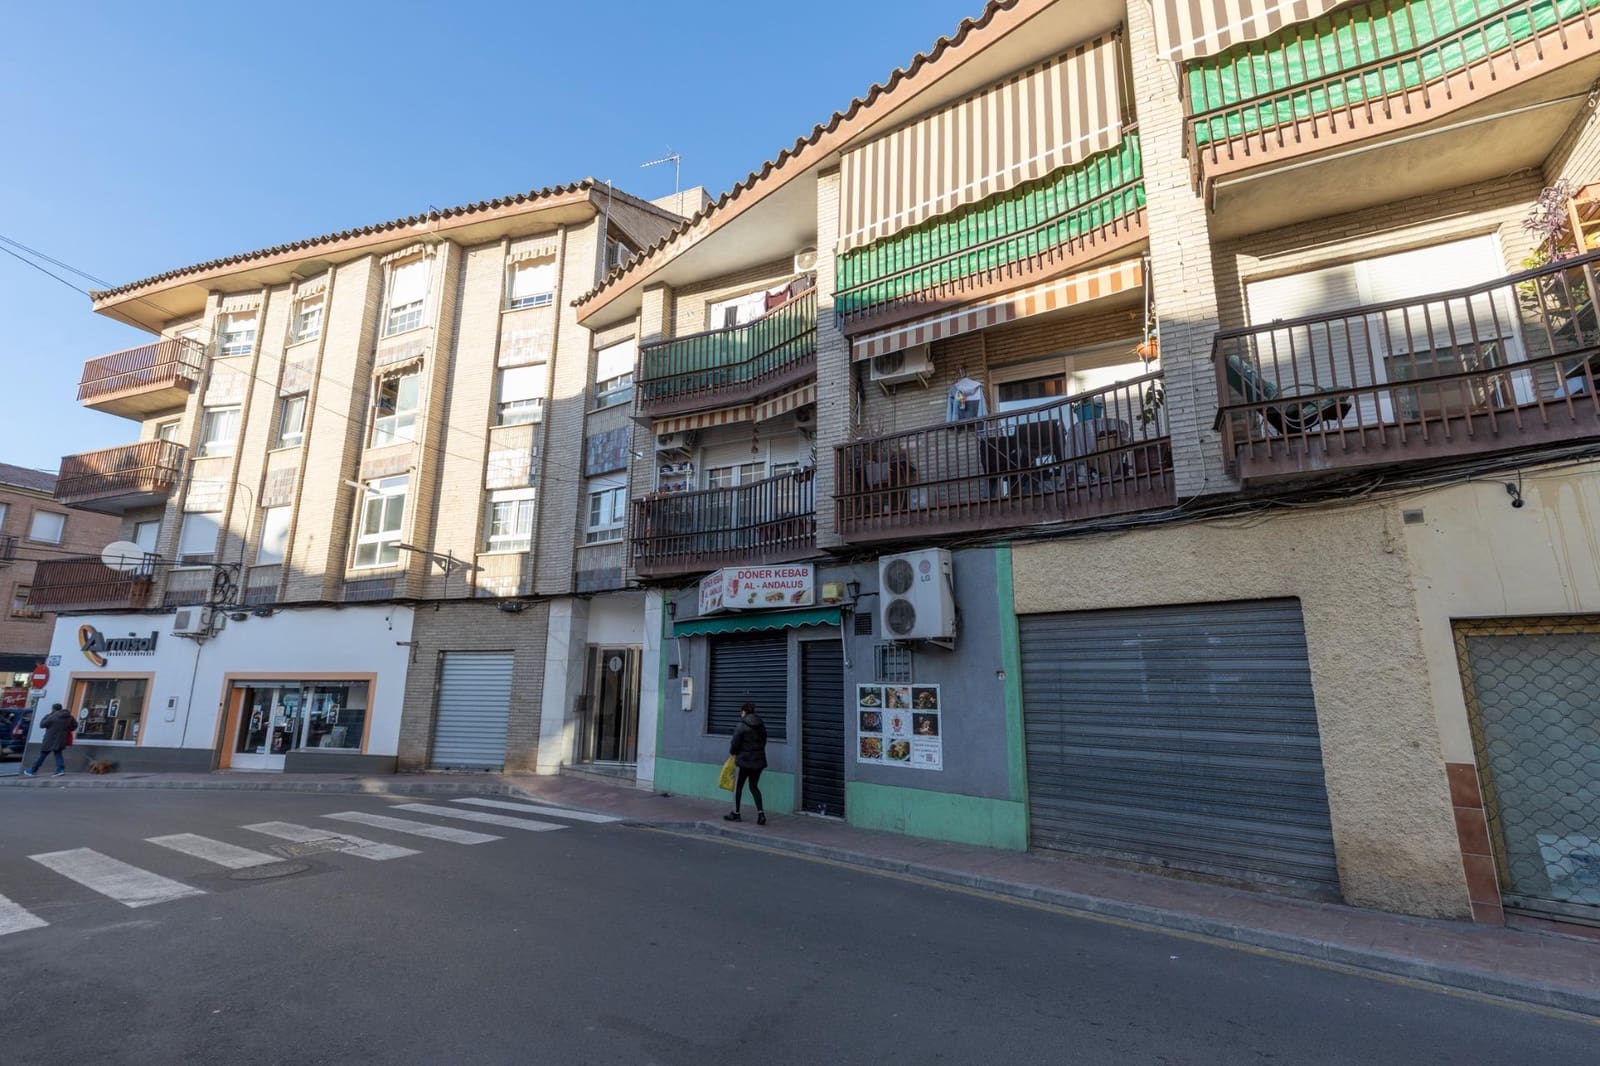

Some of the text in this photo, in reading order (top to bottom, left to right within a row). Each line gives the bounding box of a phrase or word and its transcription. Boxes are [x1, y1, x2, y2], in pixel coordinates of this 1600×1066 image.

[738, 568, 809, 580] DÖNER KEBAB
[920, 574, 931, 583] LG
[744, 582, 755, 590] AL
[762, 580, 804, 589] ANDALUS
[80, 630, 159, 652] Armisol
